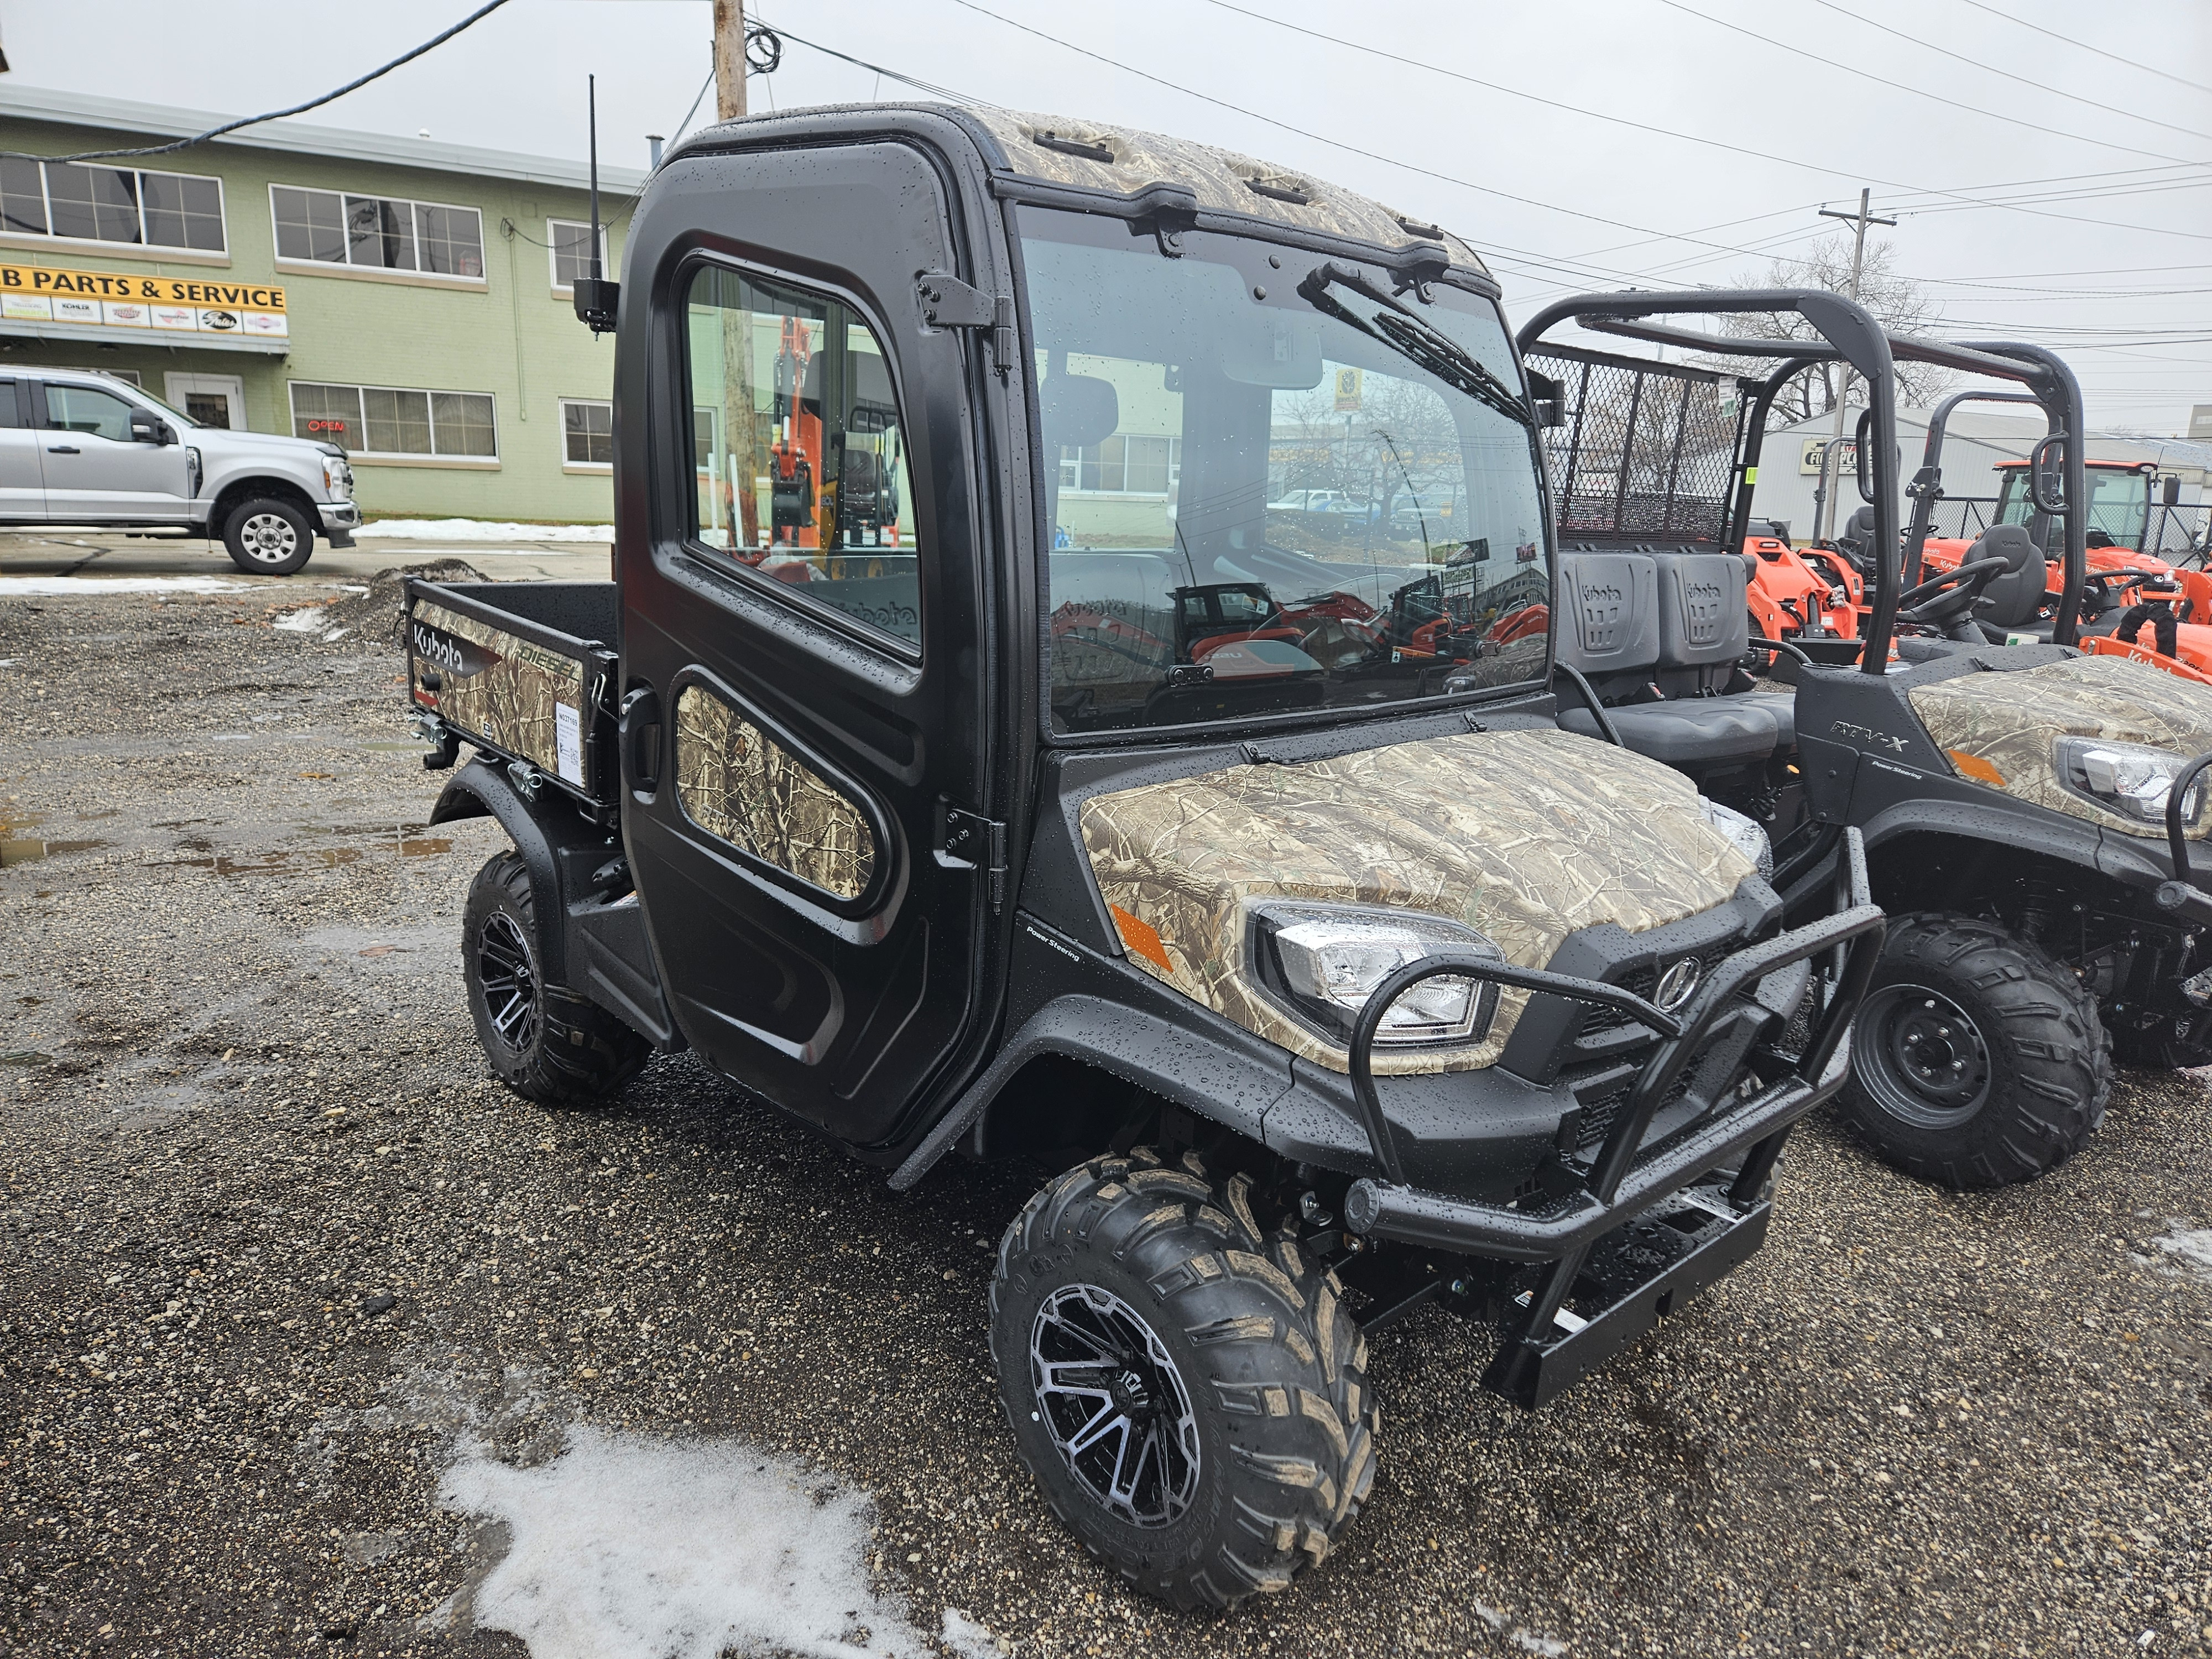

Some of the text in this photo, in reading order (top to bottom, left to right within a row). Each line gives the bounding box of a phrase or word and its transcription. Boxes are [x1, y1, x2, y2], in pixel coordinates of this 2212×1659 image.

[33, 272, 131, 295] PARTS
[141, 280, 162, 298] &
[171, 283, 284, 307] SERVICE
[204, 311, 237, 327] Gates
[307, 419, 344, 431] OPEN
[1582, 585, 1622, 601] Kubota
[1687, 583, 1721, 598] Kubota
[414, 624, 463, 671] Kubota
[519, 645, 579, 681] DIESEL
[559, 712, 577, 727] N037169
[1830, 721, 1910, 752] RTV-X
[1872, 761, 1922, 780] Power Steering
[701, 803, 759, 843] RTV-X
[1026, 926, 1080, 962] Power Steering
